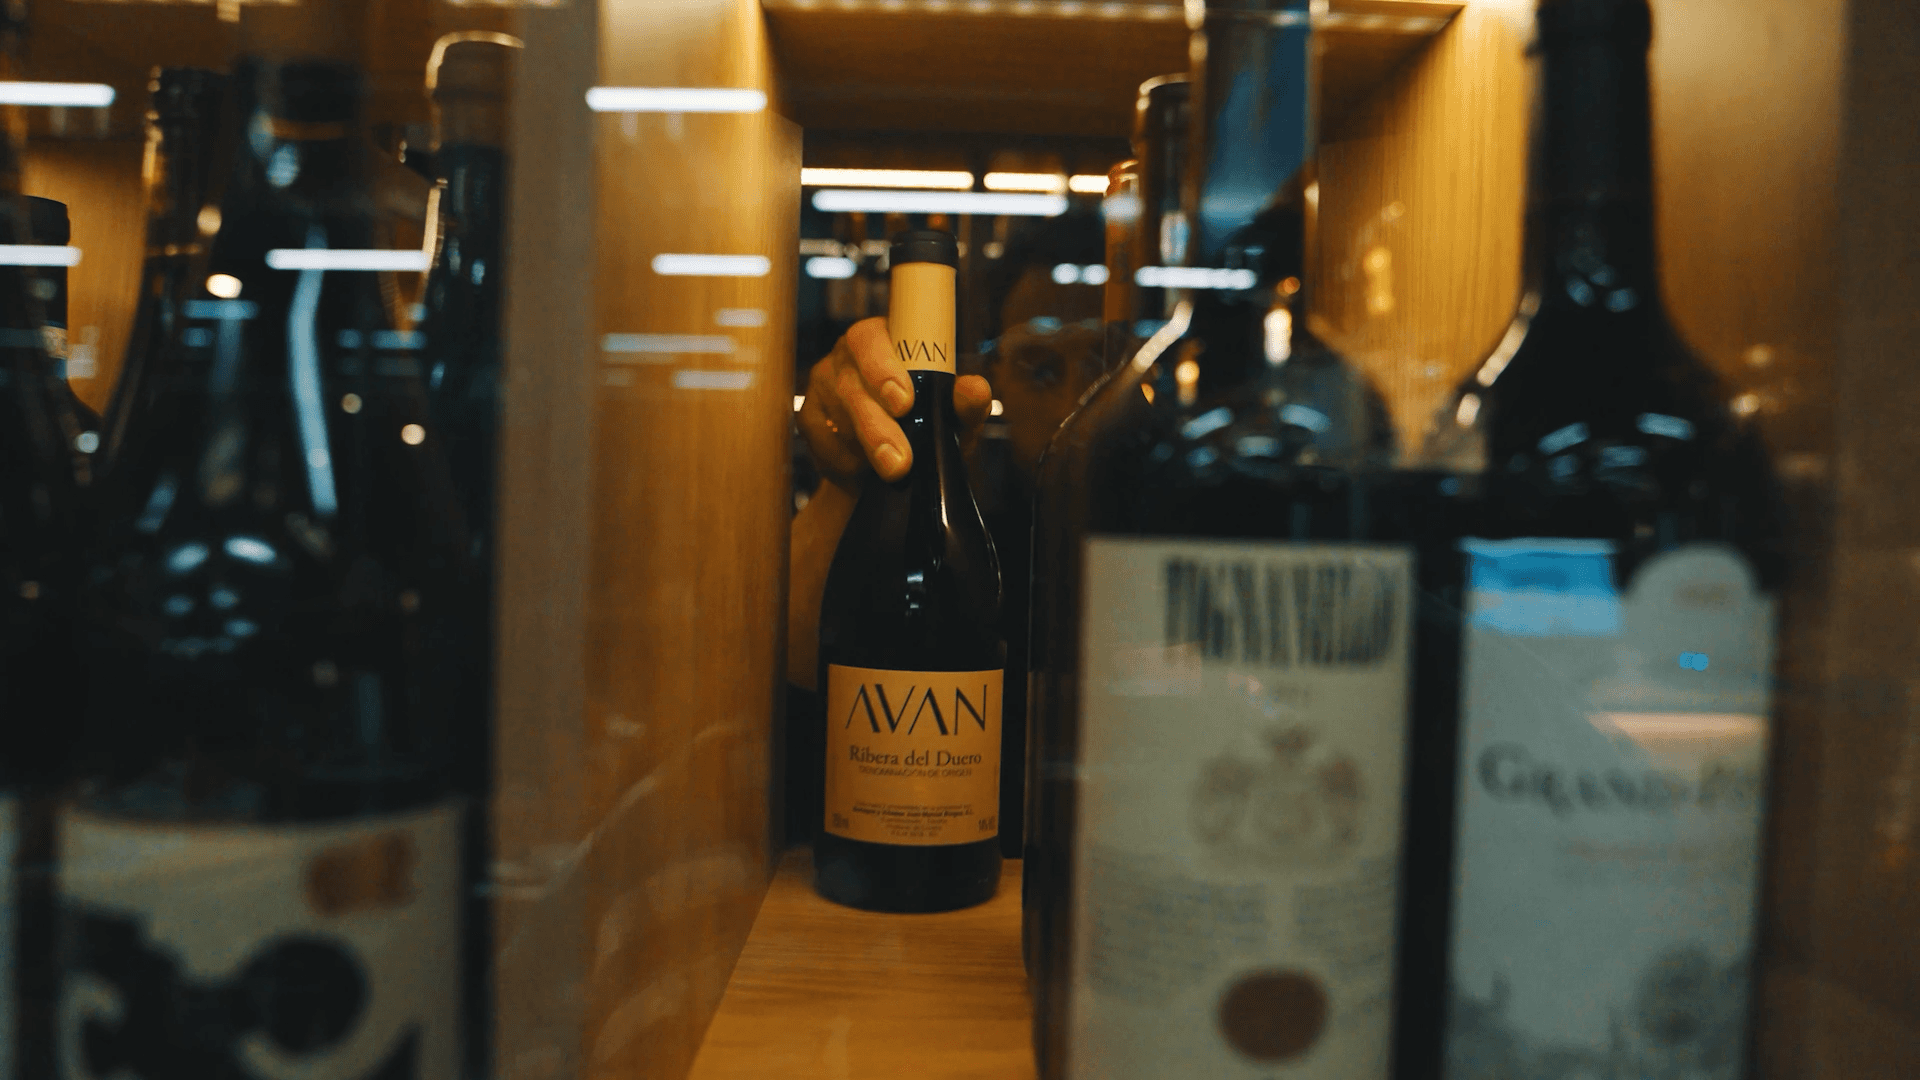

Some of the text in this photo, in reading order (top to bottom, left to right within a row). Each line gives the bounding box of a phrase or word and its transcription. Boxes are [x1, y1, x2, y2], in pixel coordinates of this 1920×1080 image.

[845, 683, 988, 736] AVAN
[849, 744, 983, 767] Ribera del Duero
